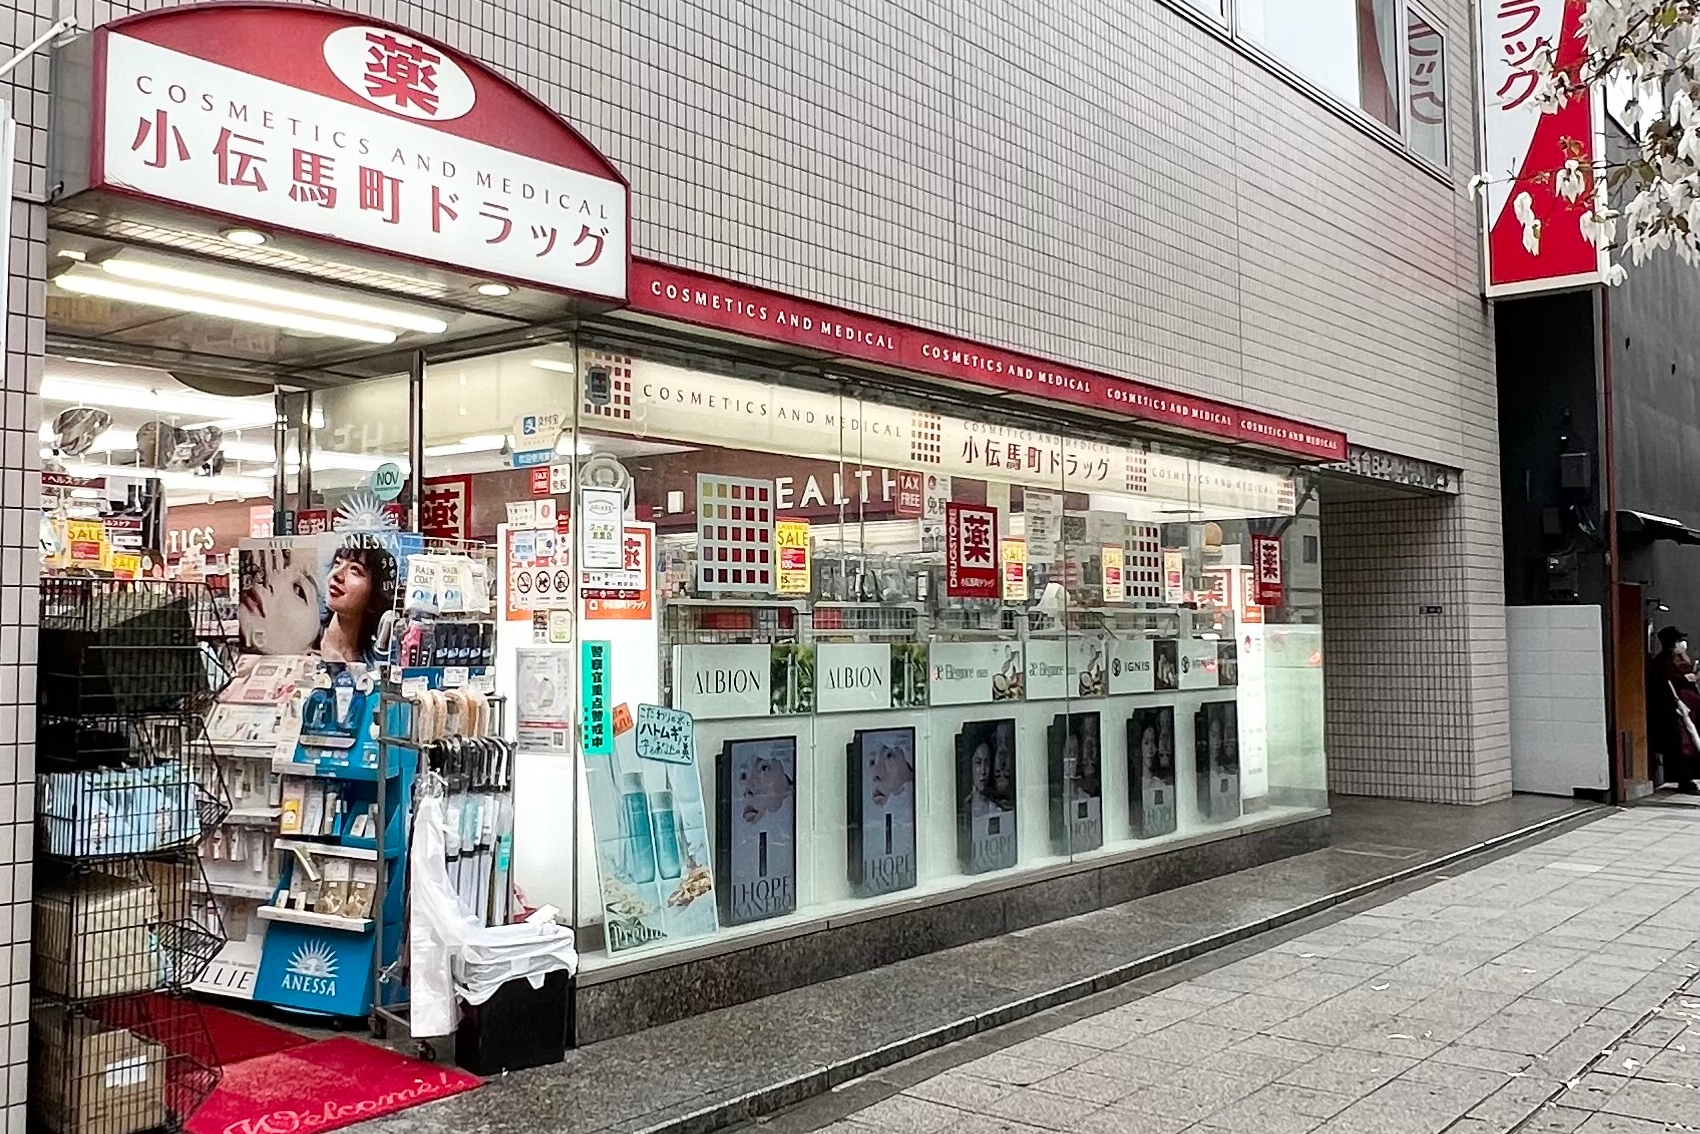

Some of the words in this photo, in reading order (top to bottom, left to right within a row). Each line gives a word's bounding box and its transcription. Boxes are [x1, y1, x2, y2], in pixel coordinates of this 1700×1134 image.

[364, 31, 442, 117] 薬
[137, 76, 371, 155] COSMETICS
[392, 147, 457, 179] AND
[477, 172, 610, 221] MEDICAL
[132, 109, 610, 269] 小伝馬町ドラッグ
[651, 281, 768, 320] COSMETICS
[777, 310, 813, 330] AND
[821, 321, 894, 350] MEDICAL
[922, 344, 1003, 373] COSMETICS
[1007, 365, 1033, 380] AND
[1038, 371, 1090, 393] MEDICAL
[643, 384, 767, 416] COSMETICS
[778, 407, 815, 424] AND
[825, 414, 902, 438] MEDICAL
[1107, 388, 1166, 412] COSMETICS
[1170, 402, 1189, 416] AND
[1191, 408, 1232, 426] MEDICAL
[964, 421, 1033, 441] COSMETICS
[1241, 420, 1287, 439] COSMETICS
[1289, 430, 1305, 443] AND
[1305, 433, 1338, 450] MEDICAL
[962, 435, 1110, 482] 小伝馬町ドラッグ
[48, 475, 90, 486] ヘルスケア
[377, 471, 400, 486] NOV
[900, 474, 920, 490] TAX
[1152, 467, 1210, 485] COSMETICS
[900, 492, 920, 508] FREE
[67, 527, 104, 541] SALE
[169, 526, 215, 553] TICS
[342, 532, 400, 550] ANESSA
[777, 530, 808, 547] SALE
[963, 514, 991, 563] 薬
[949, 508, 958, 588] DRUGSTORE
[1003, 547, 1025, 561] SALE
[112, 557, 139, 569] SALE
[415, 564, 435, 576] RAIN
[1262, 543, 1278, 579] 薬
[414, 575, 434, 584] COAT
[826, 665, 883, 689] ALBION
[1125, 661, 1150, 672] IGNIS
[693, 669, 760, 694] ALBION
[640, 722, 683, 742] ハトムギ
[281, 973, 337, 996] ANESSA
